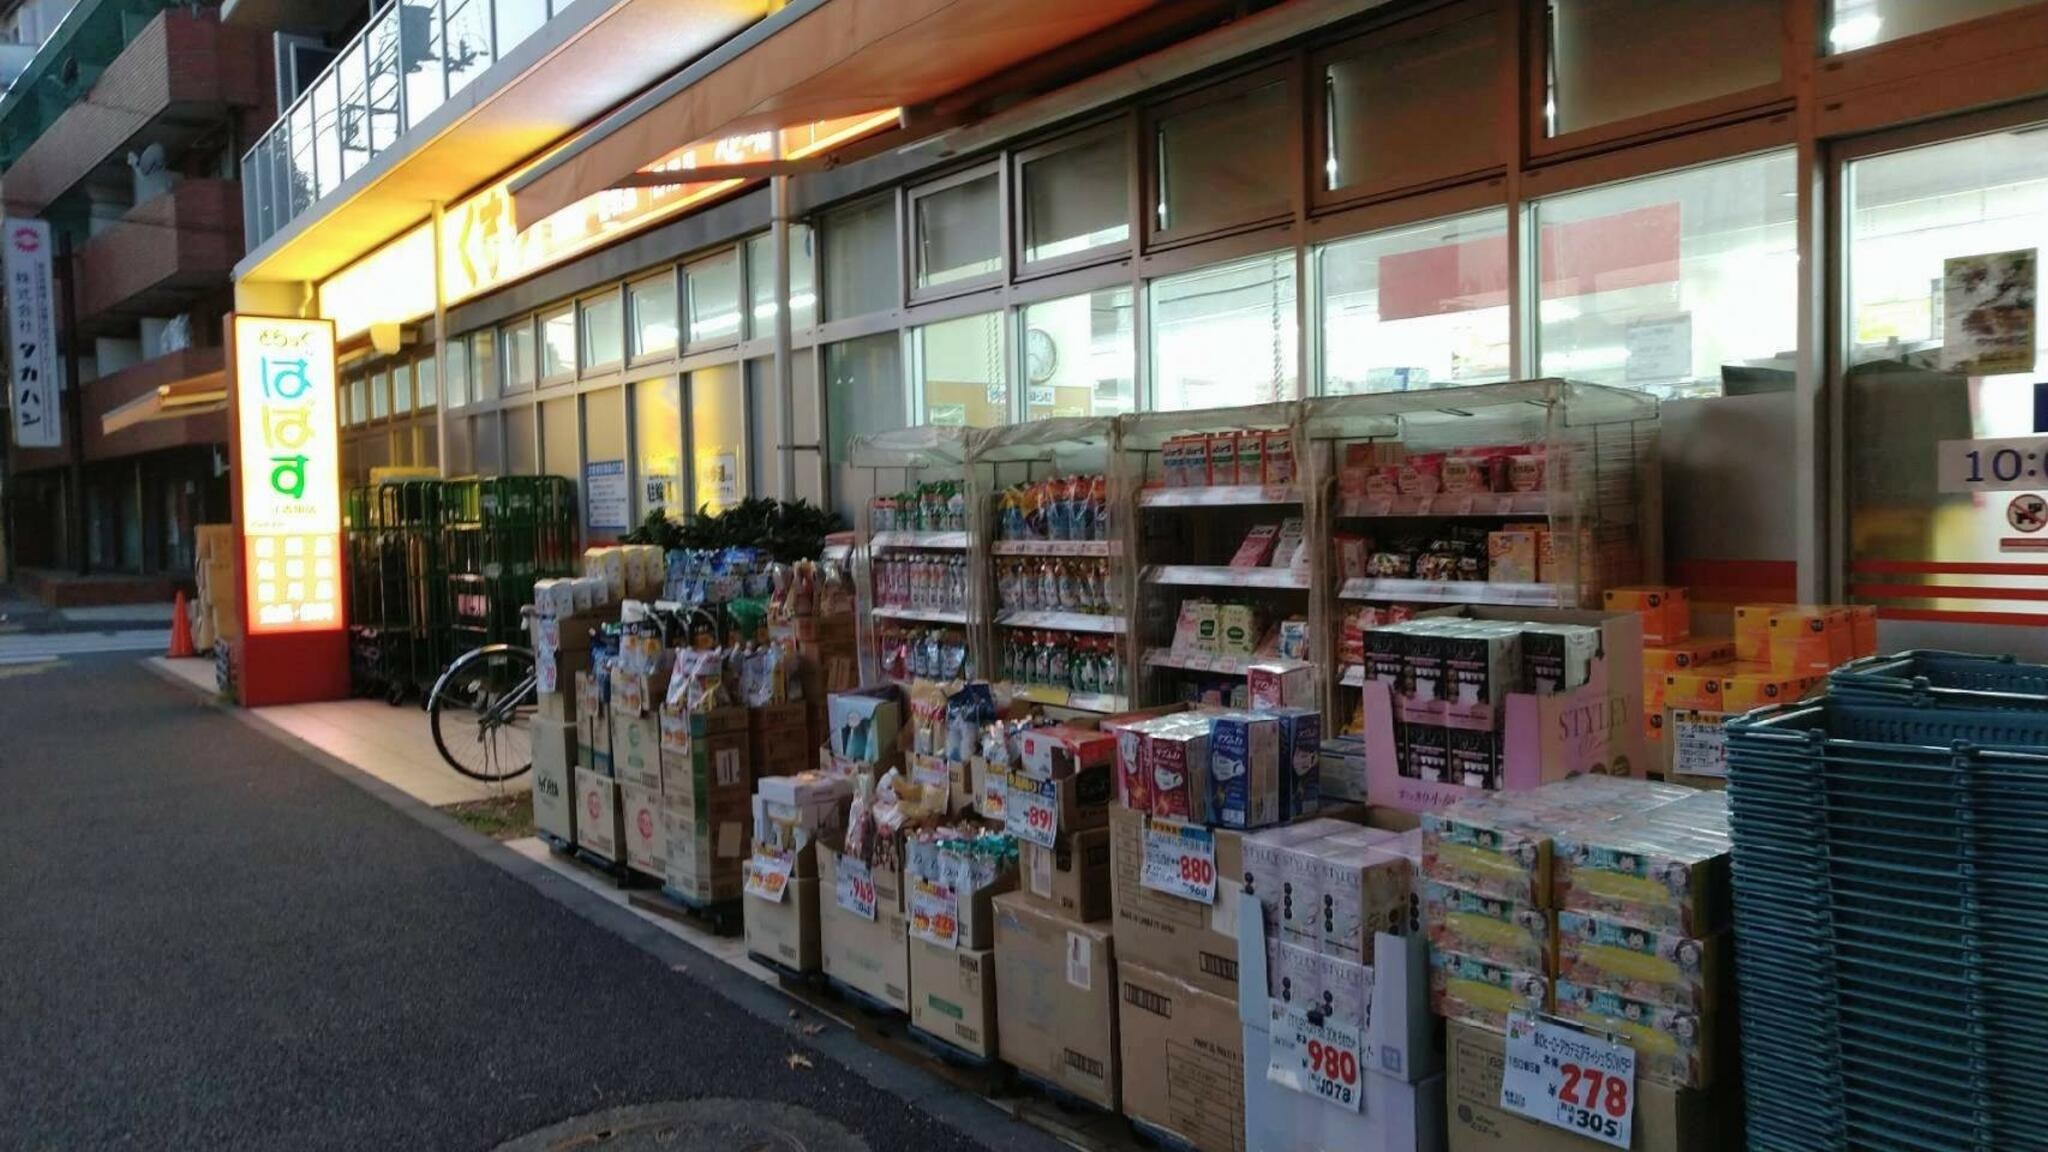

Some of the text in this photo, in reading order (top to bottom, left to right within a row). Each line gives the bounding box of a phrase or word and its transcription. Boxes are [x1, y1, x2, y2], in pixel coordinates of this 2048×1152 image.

[1965, 449, 2048, 481] 10:
[1180, 855, 1212, 885] 880
[1308, 1040, 1357, 1085] 980
[1559, 1063, 1627, 1117] 278
